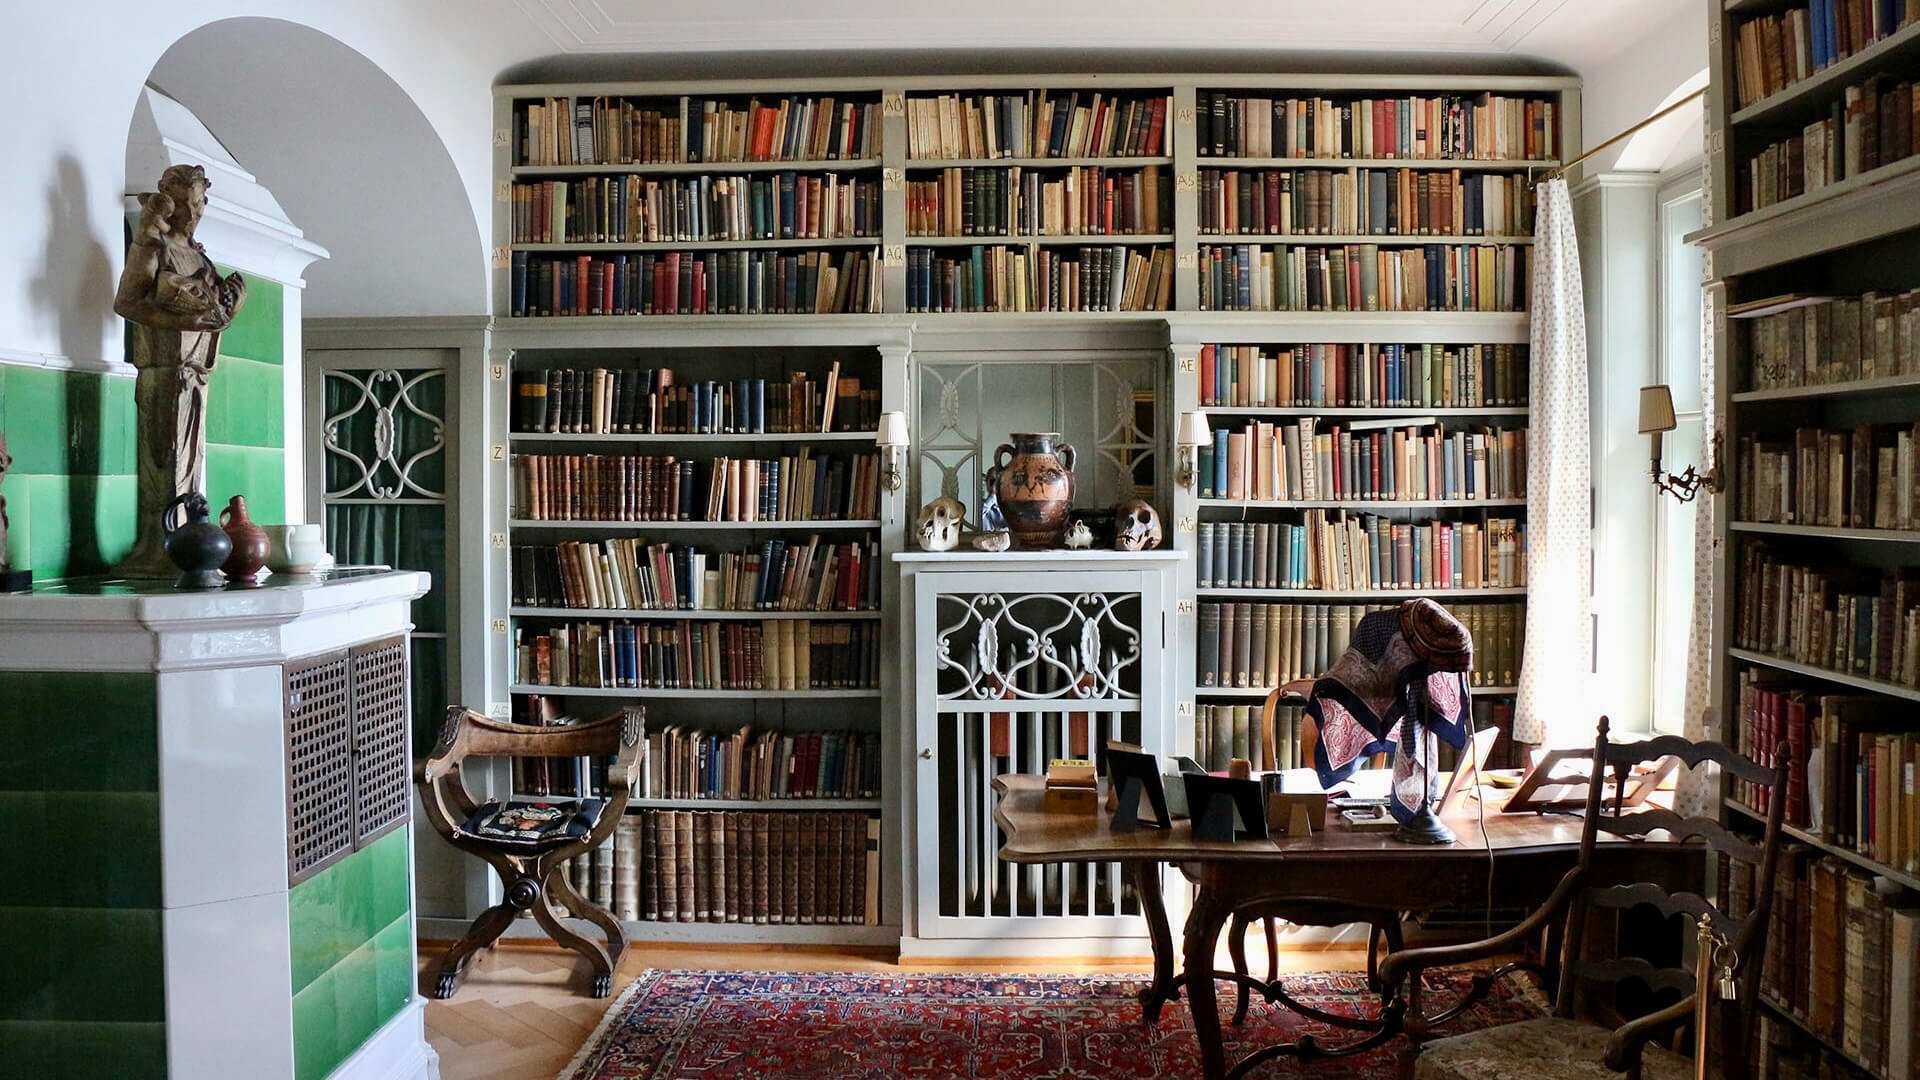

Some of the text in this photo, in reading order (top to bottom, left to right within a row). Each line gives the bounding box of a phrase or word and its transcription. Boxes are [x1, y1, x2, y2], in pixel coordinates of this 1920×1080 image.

[884, 97, 903, 113] AO
[886, 247, 903, 262] AQ
[1179, 359, 1195, 372] AE
[493, 446, 503, 460] Z
[1178, 601, 1193, 614] AH
